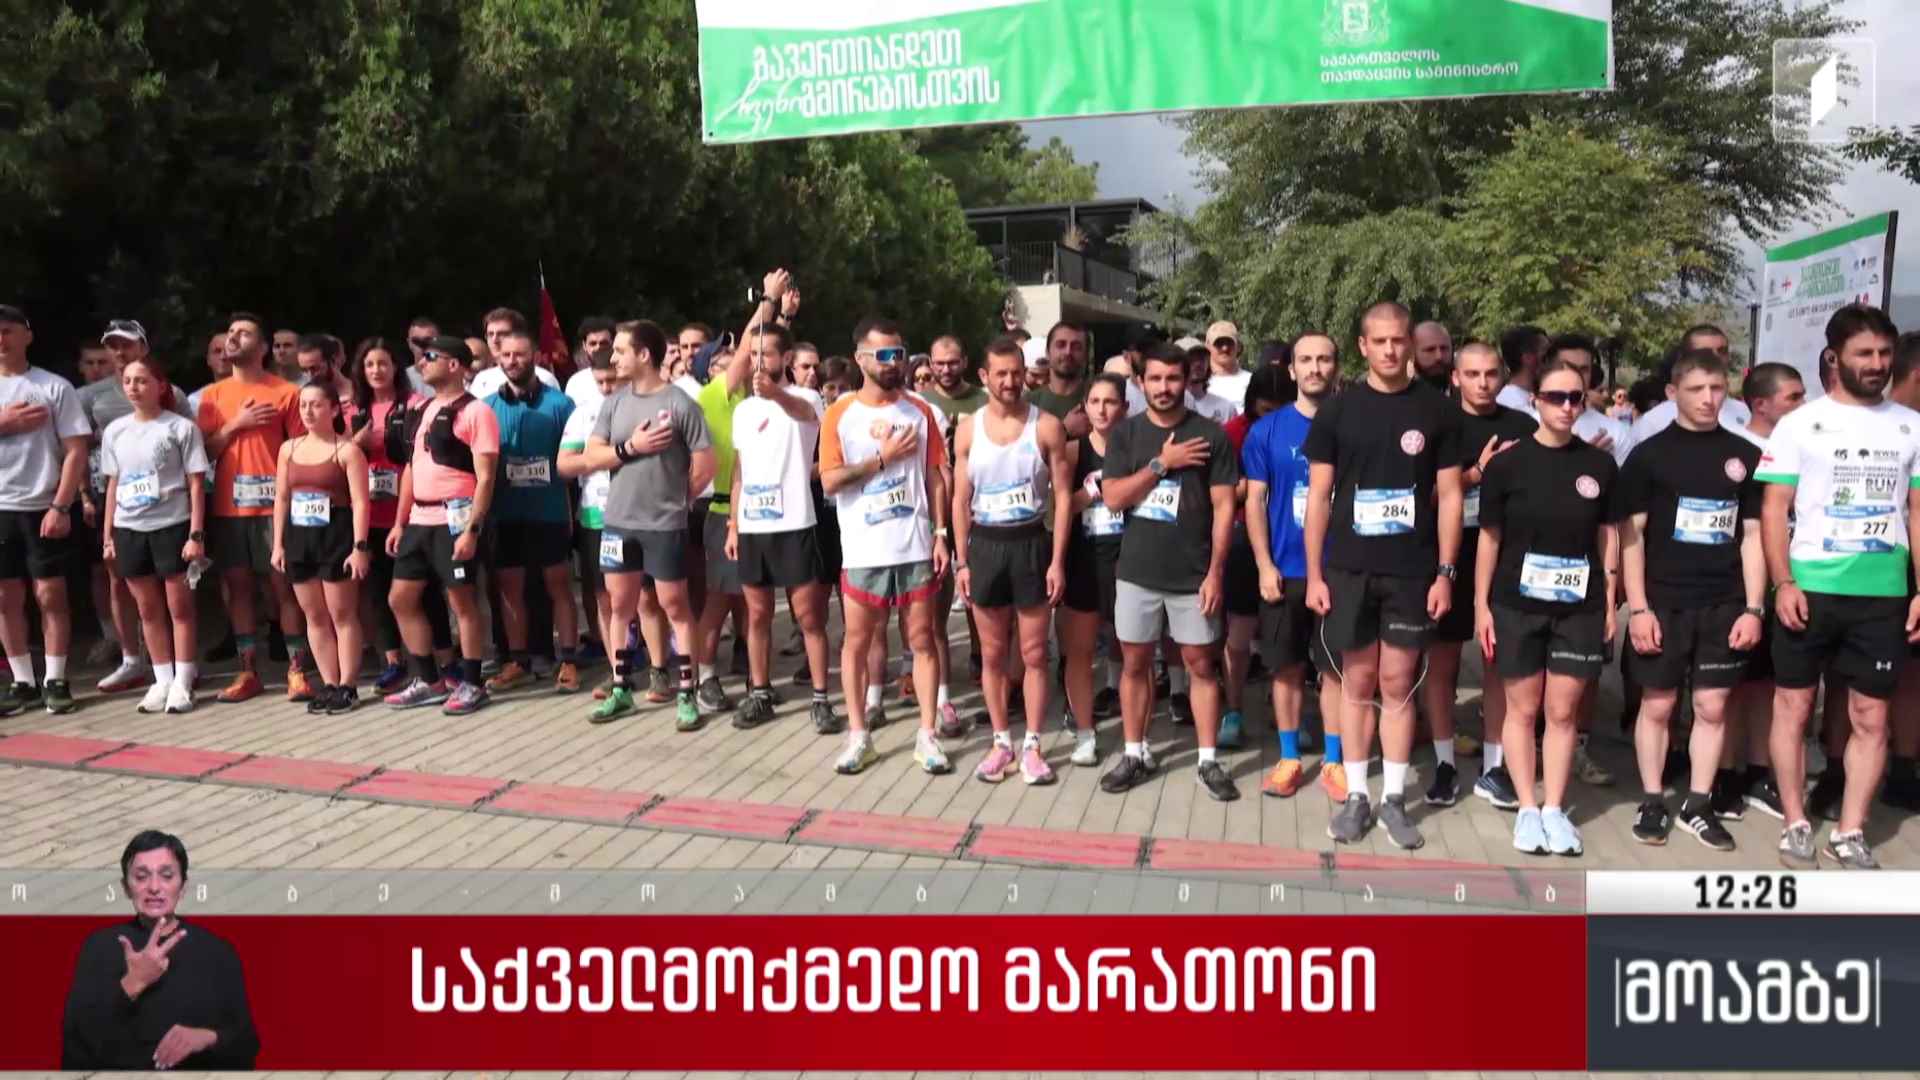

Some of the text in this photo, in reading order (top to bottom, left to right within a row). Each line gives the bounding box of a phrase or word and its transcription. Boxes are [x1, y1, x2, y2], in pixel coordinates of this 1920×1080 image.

[1320, 49, 1441, 67] საქართველოს
[1321, 61, 1520, 83] თავდაცვის სამინისტრო
[1865, 478, 1897, 493] RUN
[758, 496, 776, 507] 332
[1006, 492, 1027, 505] 311
[303, 503, 324, 514] 259
[1381, 505, 1409, 519] 284
[1862, 521, 1889, 535] 277
[1553, 571, 1582, 588] 285
